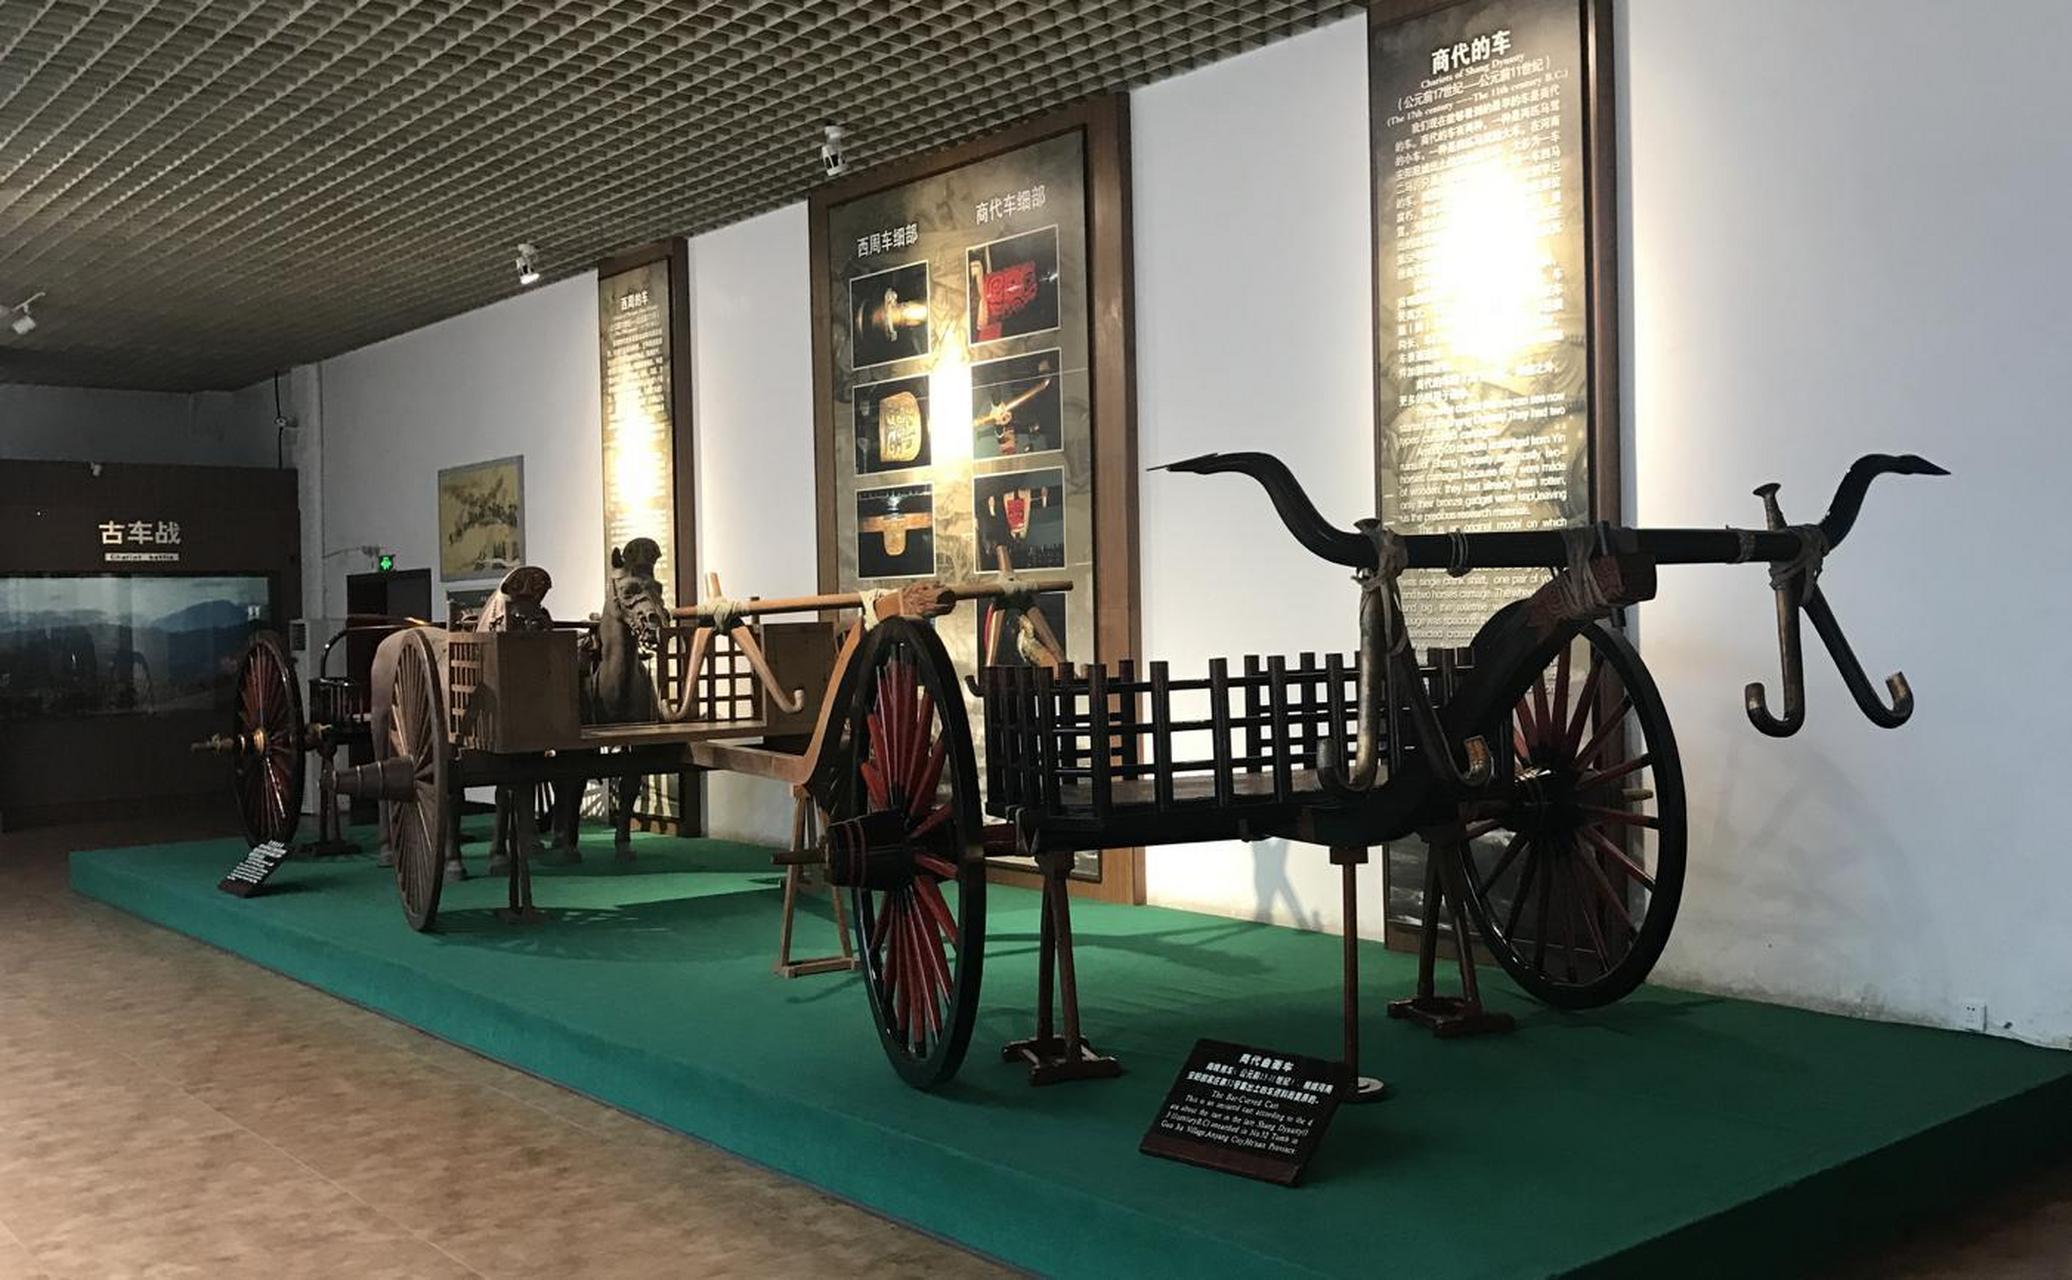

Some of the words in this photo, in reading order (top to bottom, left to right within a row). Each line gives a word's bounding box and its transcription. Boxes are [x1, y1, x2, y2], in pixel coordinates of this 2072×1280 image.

[1431, 30, 1511, 74] 商代的车
[976, 185, 1047, 225] 商代车细部
[857, 223, 919, 258] 西周车细部
[98, 519, 182, 545] 古车战
[1541, 517, 1568, 529] which
